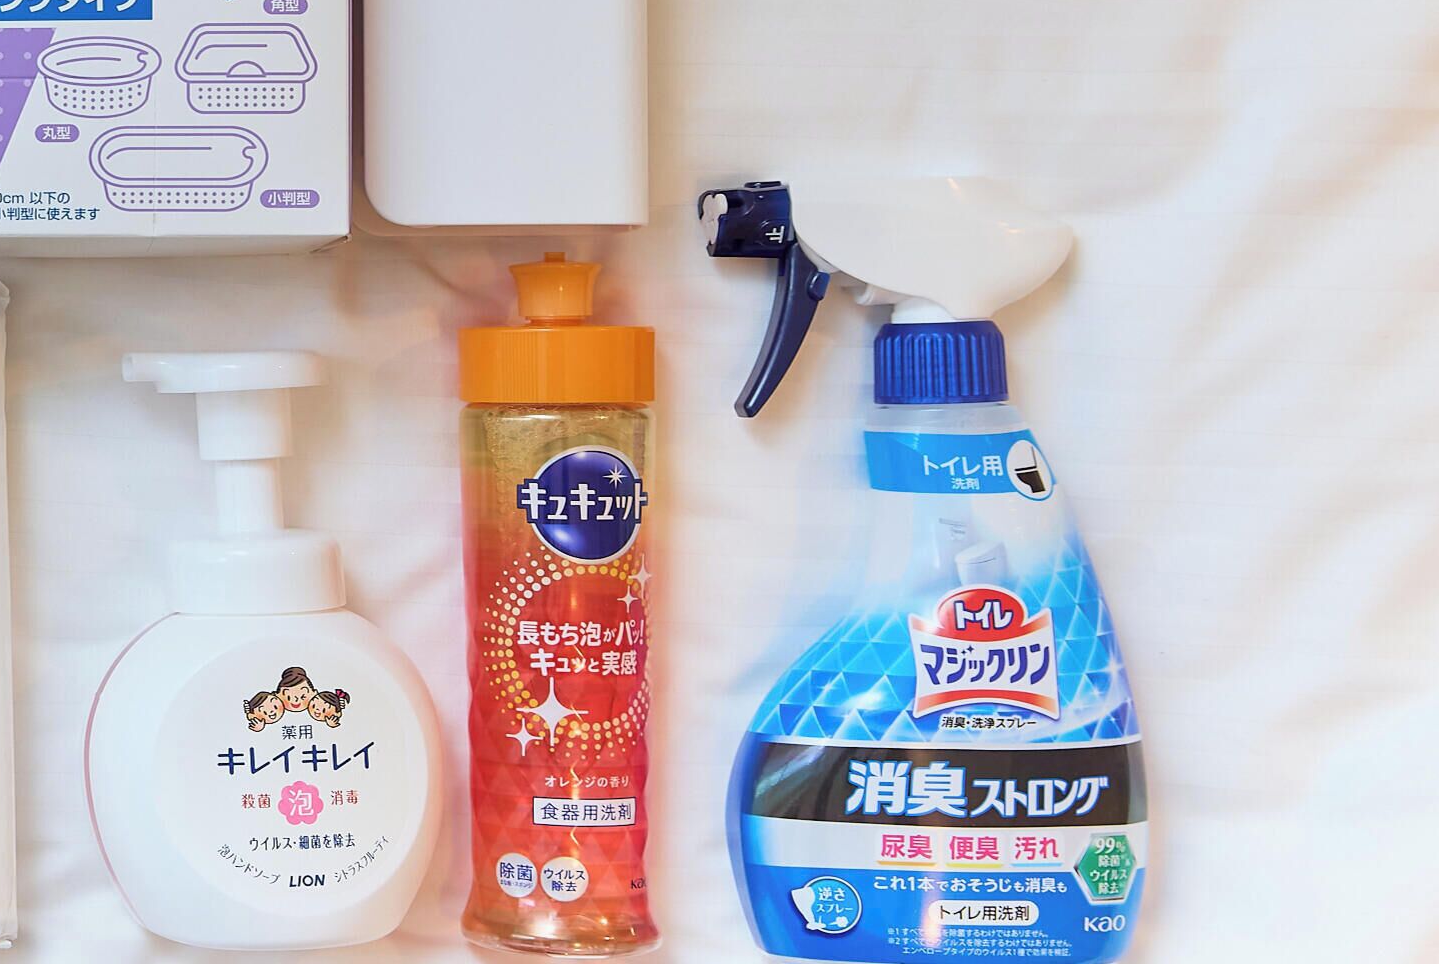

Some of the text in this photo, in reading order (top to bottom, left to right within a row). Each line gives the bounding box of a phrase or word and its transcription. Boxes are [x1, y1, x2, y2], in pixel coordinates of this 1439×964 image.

[41, 125, 72, 141] 丸型
[29, 191, 71, 204] 以下の
[266, 189, 311, 206] 小判型
[921, 455, 1003, 476] トイレ用
[951, 477, 980, 490] 洗剤
[521, 480, 649, 522] キュキュット
[954, 600, 1014, 630] トイレ
[920, 643, 1052, 686] マジックリン
[281, 724, 313, 740] 薬用
[217, 741, 375, 775] キレイキレイ
[545, 774, 630, 789] オレンジの香り
[847, 761, 1109, 818] 消臭 ストロング
[241, 793, 272, 809] 殺菌
[288, 789, 315, 817] 泡
[330, 789, 360, 806] 消毒
[539, 802, 632, 821] 食器用洗剤
[248, 833, 356, 852] ウイルス・細菌を除去
[880, 834, 1060, 860] 尿臭 便臭 汚れ
[217, 843, 280, 885] 泡ハンドソープ
[499, 862, 534, 882] 除菌
[288, 873, 326, 888] LION
[543, 868, 586, 880] ウイルス
[551, 880, 577, 892] 除去
[818, 887, 845, 902] 逆さ
[816, 903, 854, 913] スプレー
[939, 904, 1030, 923] トイレ用洗剤
[1084, 915, 1126, 932] Kao
